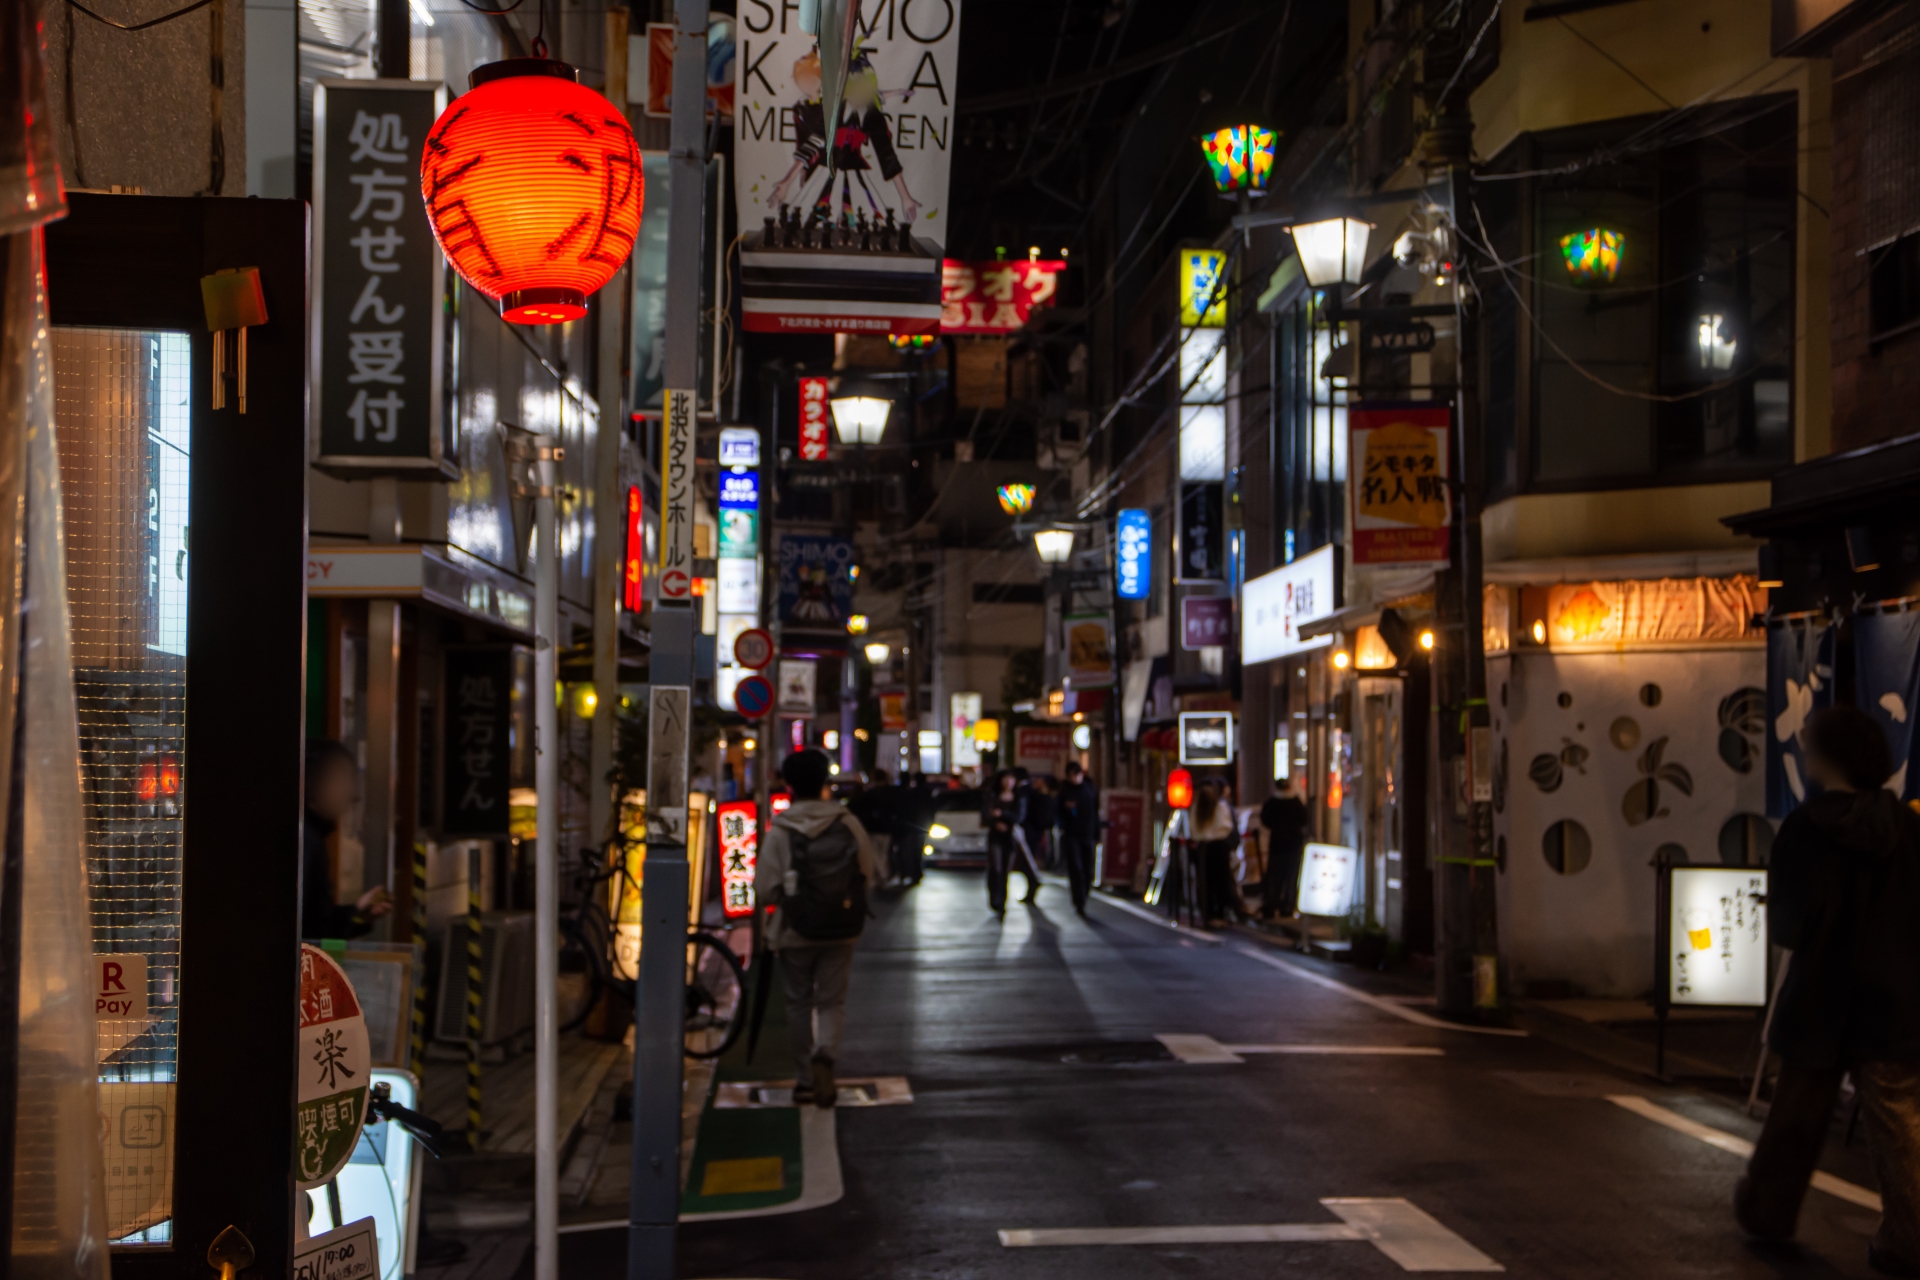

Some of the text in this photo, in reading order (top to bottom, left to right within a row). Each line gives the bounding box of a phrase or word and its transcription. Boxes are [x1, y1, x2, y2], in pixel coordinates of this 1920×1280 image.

[347, 110, 408, 443] 処方せん受付
[803, 379, 825, 460] カラオケ
[667, 392, 689, 567] 北沢タウンホール
[1366, 455, 1437, 473] シモキタ
[1360, 475, 1445, 505] 名人戦
[781, 541, 852, 563] SHIMO
[739, 637, 764, 656] 30
[458, 673, 497, 812] 処方せん
[103, 962, 126, 990] R
[96, 999, 133, 1016] Pay
[313, 1028, 355, 1089] 楽
[299, 1097, 355, 1139] 喫煙可
